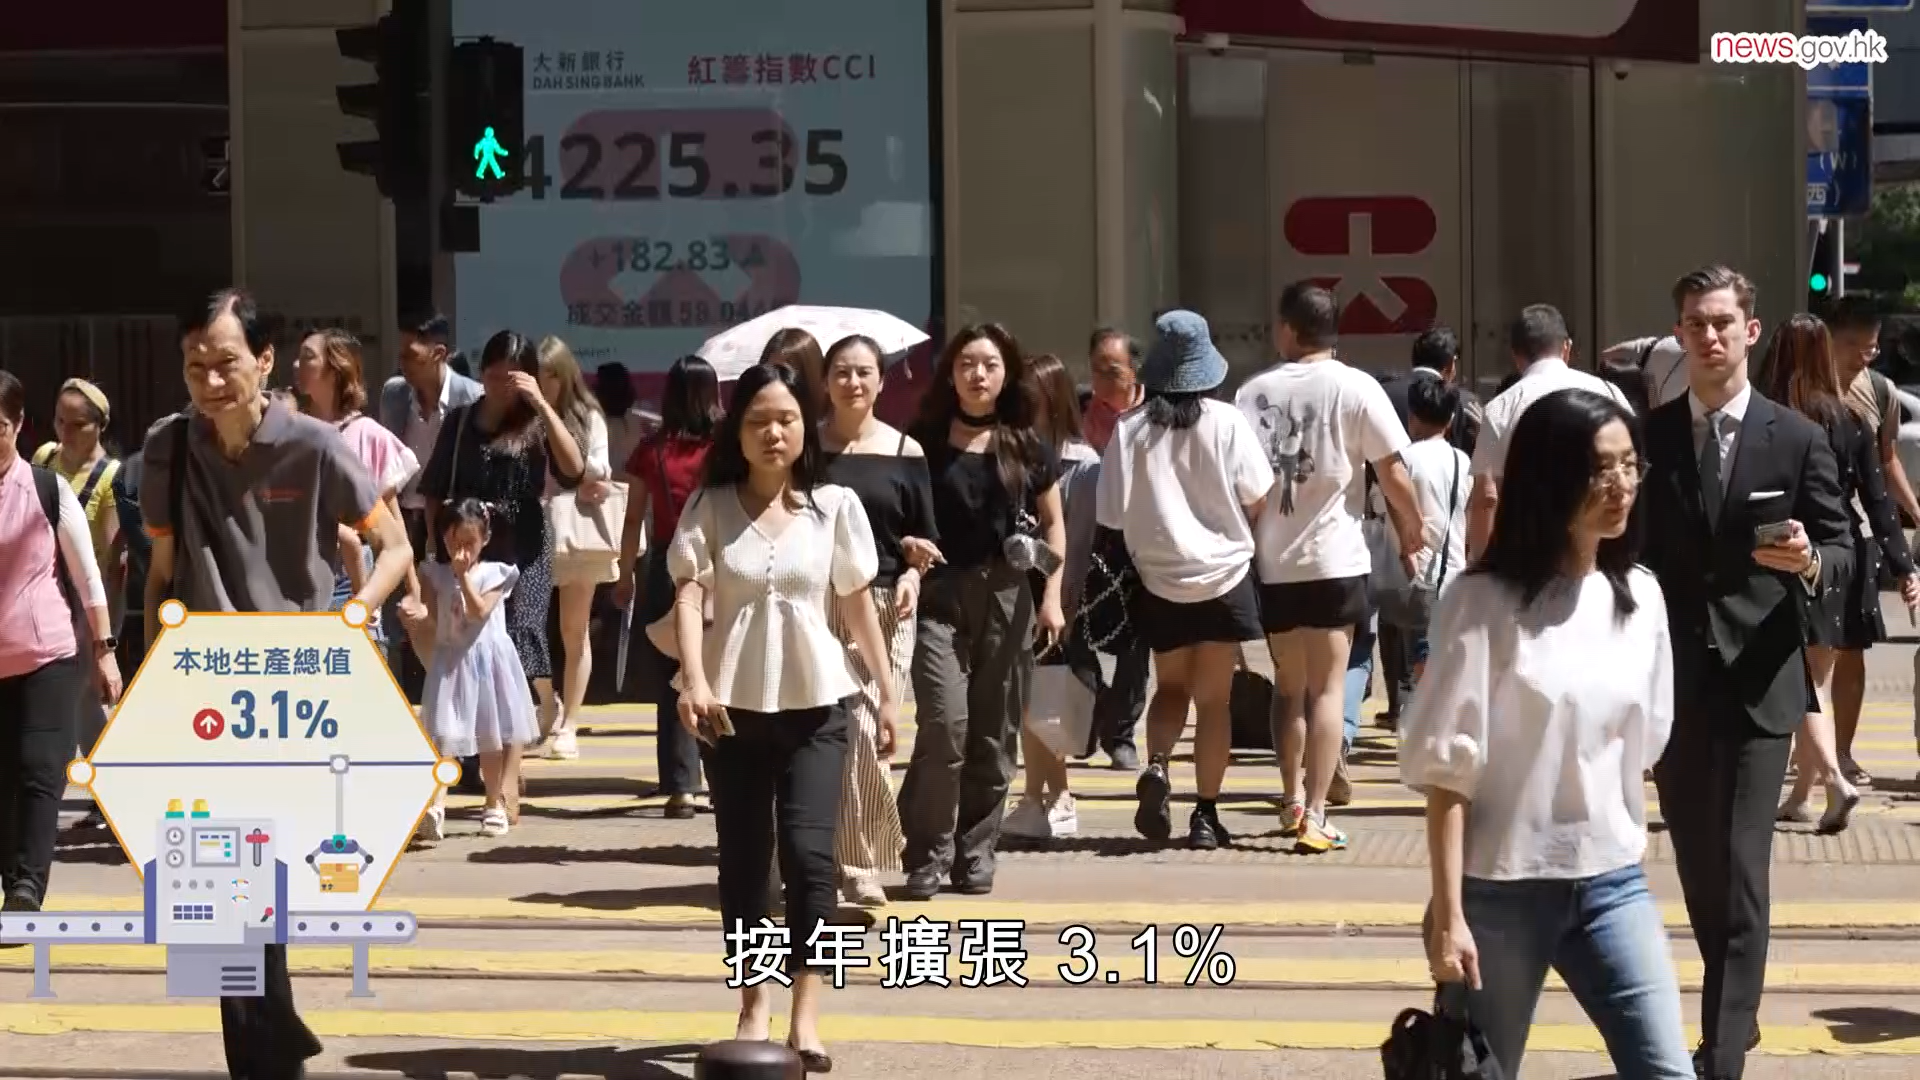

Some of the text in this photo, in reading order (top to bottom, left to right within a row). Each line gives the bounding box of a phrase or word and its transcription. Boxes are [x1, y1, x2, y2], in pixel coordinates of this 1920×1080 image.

[533, 74, 645, 89] DAH SING BANK
